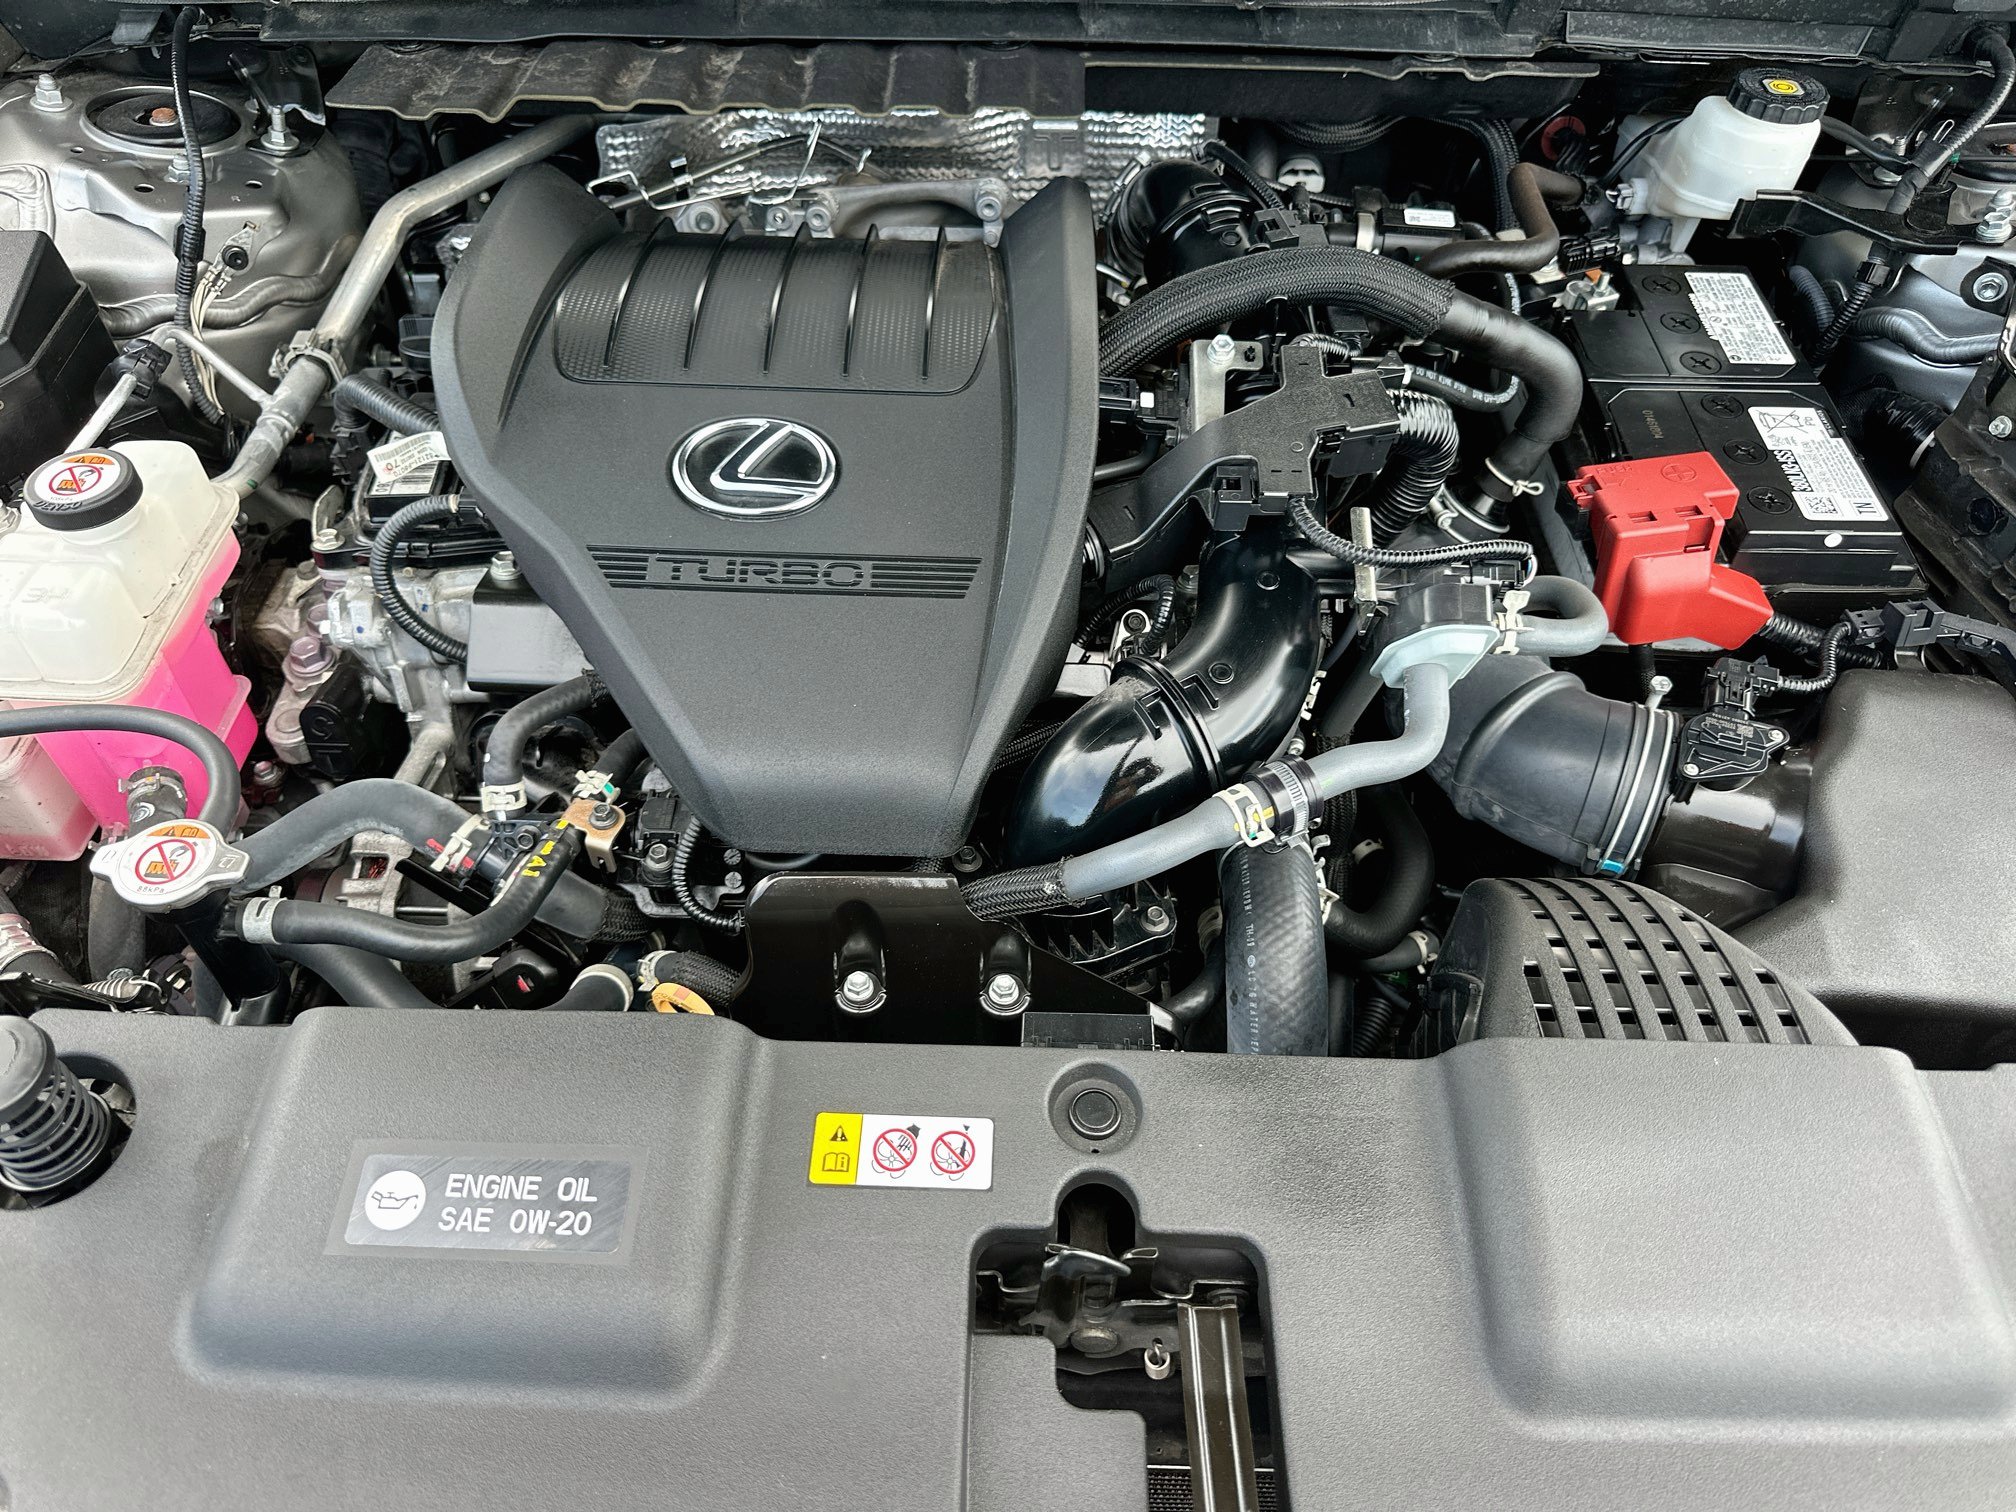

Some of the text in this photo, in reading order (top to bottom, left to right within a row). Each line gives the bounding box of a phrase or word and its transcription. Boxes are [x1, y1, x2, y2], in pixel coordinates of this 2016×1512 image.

[1426, 370, 1438, 380] NOT
[33, 500, 82, 512] DENSO
[1853, 502, 1877, 515] TN
[656, 556, 864, 587] TURBO
[136, 884, 165, 893] 88kPa
[445, 1174, 598, 1203] ENGINE OIL
[438, 1206, 593, 1236] SAE 0W-20
